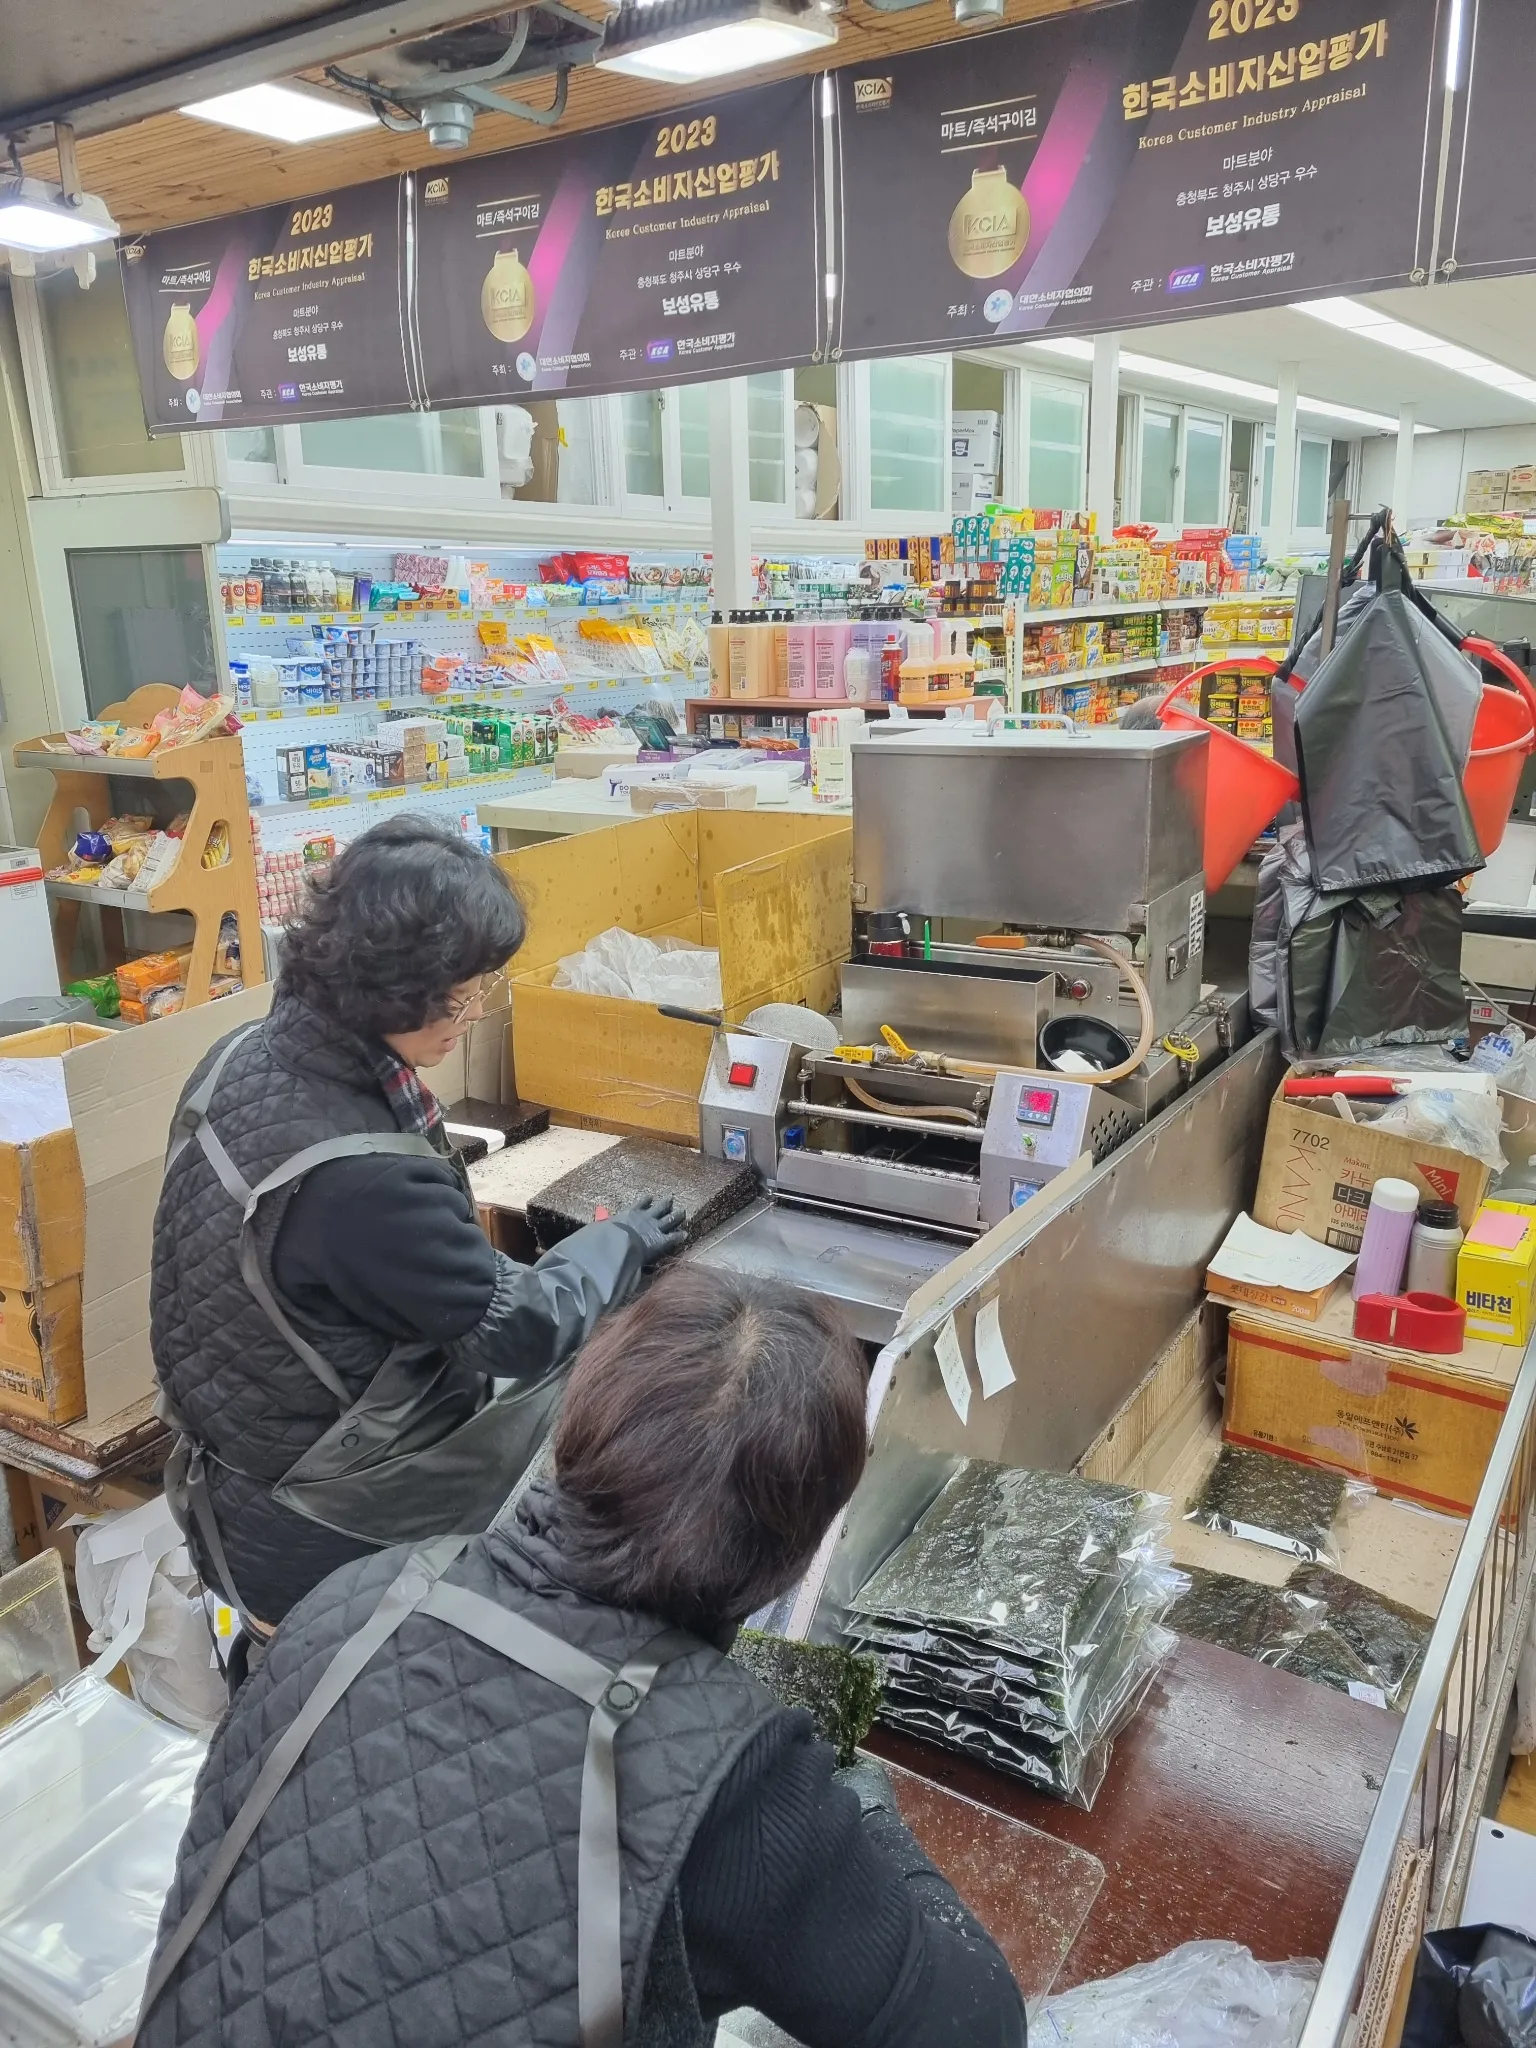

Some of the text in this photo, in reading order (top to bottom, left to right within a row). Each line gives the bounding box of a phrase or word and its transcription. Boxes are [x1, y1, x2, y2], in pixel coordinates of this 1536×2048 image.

[1122, 18, 1389, 121] 한국소비자산업평가
[941, 107, 1037, 140] 마트/즉석구이김
[1138, 83, 1366, 149] Korea Customer Industry Appraisal
[655, 115, 717, 157] 2023
[1223, 147, 1273, 172] 마트분야
[595, 150, 780, 216] 한국소비자산업평가
[1175, 164, 1318, 207] 충청북도 청주시 상당구 우수
[291, 204, 334, 236] 2023
[476, 203, 541, 227] 마트/즉석구이김
[606, 200, 770, 240] Korea Customer Industry Appraisal
[967, 214, 1010, 235] KCIA
[1205, 203, 1281, 237] 보성유통
[248, 233, 374, 281] 한국소비자산업평가
[669, 243, 704, 262] 마트분야
[637, 261, 742, 289] 충청북도 청주시 상당구 우수
[1210, 252, 1295, 277] 한국소비자평가
[1210, 264, 1293, 283] Korea Customer Appraisal
[161, 269, 211, 285] 마트/즉석구이김
[302, 279, 329, 292] Industry
[331, 272, 366, 287] Appraisal
[1131, 278, 1154, 293] 주관
[1172, 273, 1199, 286] KCA
[662, 290, 720, 316] 보성유통
[1019, 286, 1093, 304] 대한소비자협의회
[293, 304, 319, 319] 마트분야
[947, 305, 967, 317] 주최
[293, 325, 310, 337] 청주시
[311, 322, 329, 334] 상당구
[330, 320, 344, 331] 우수
[677, 332, 736, 350] 한국소비자평가
[287, 343, 328, 363] 보성유통
[619, 349, 637, 361] 주관
[299, 380, 344, 393] 한국소비자평가
[1292, 1128, 1330, 1150] 7702
[1340, 1168, 1372, 1188] 카누
[1425, 1168, 1452, 1197] Mini
[1336, 1187, 1366, 1206] 다크
[1466, 1290, 1512, 1314] 비타천
